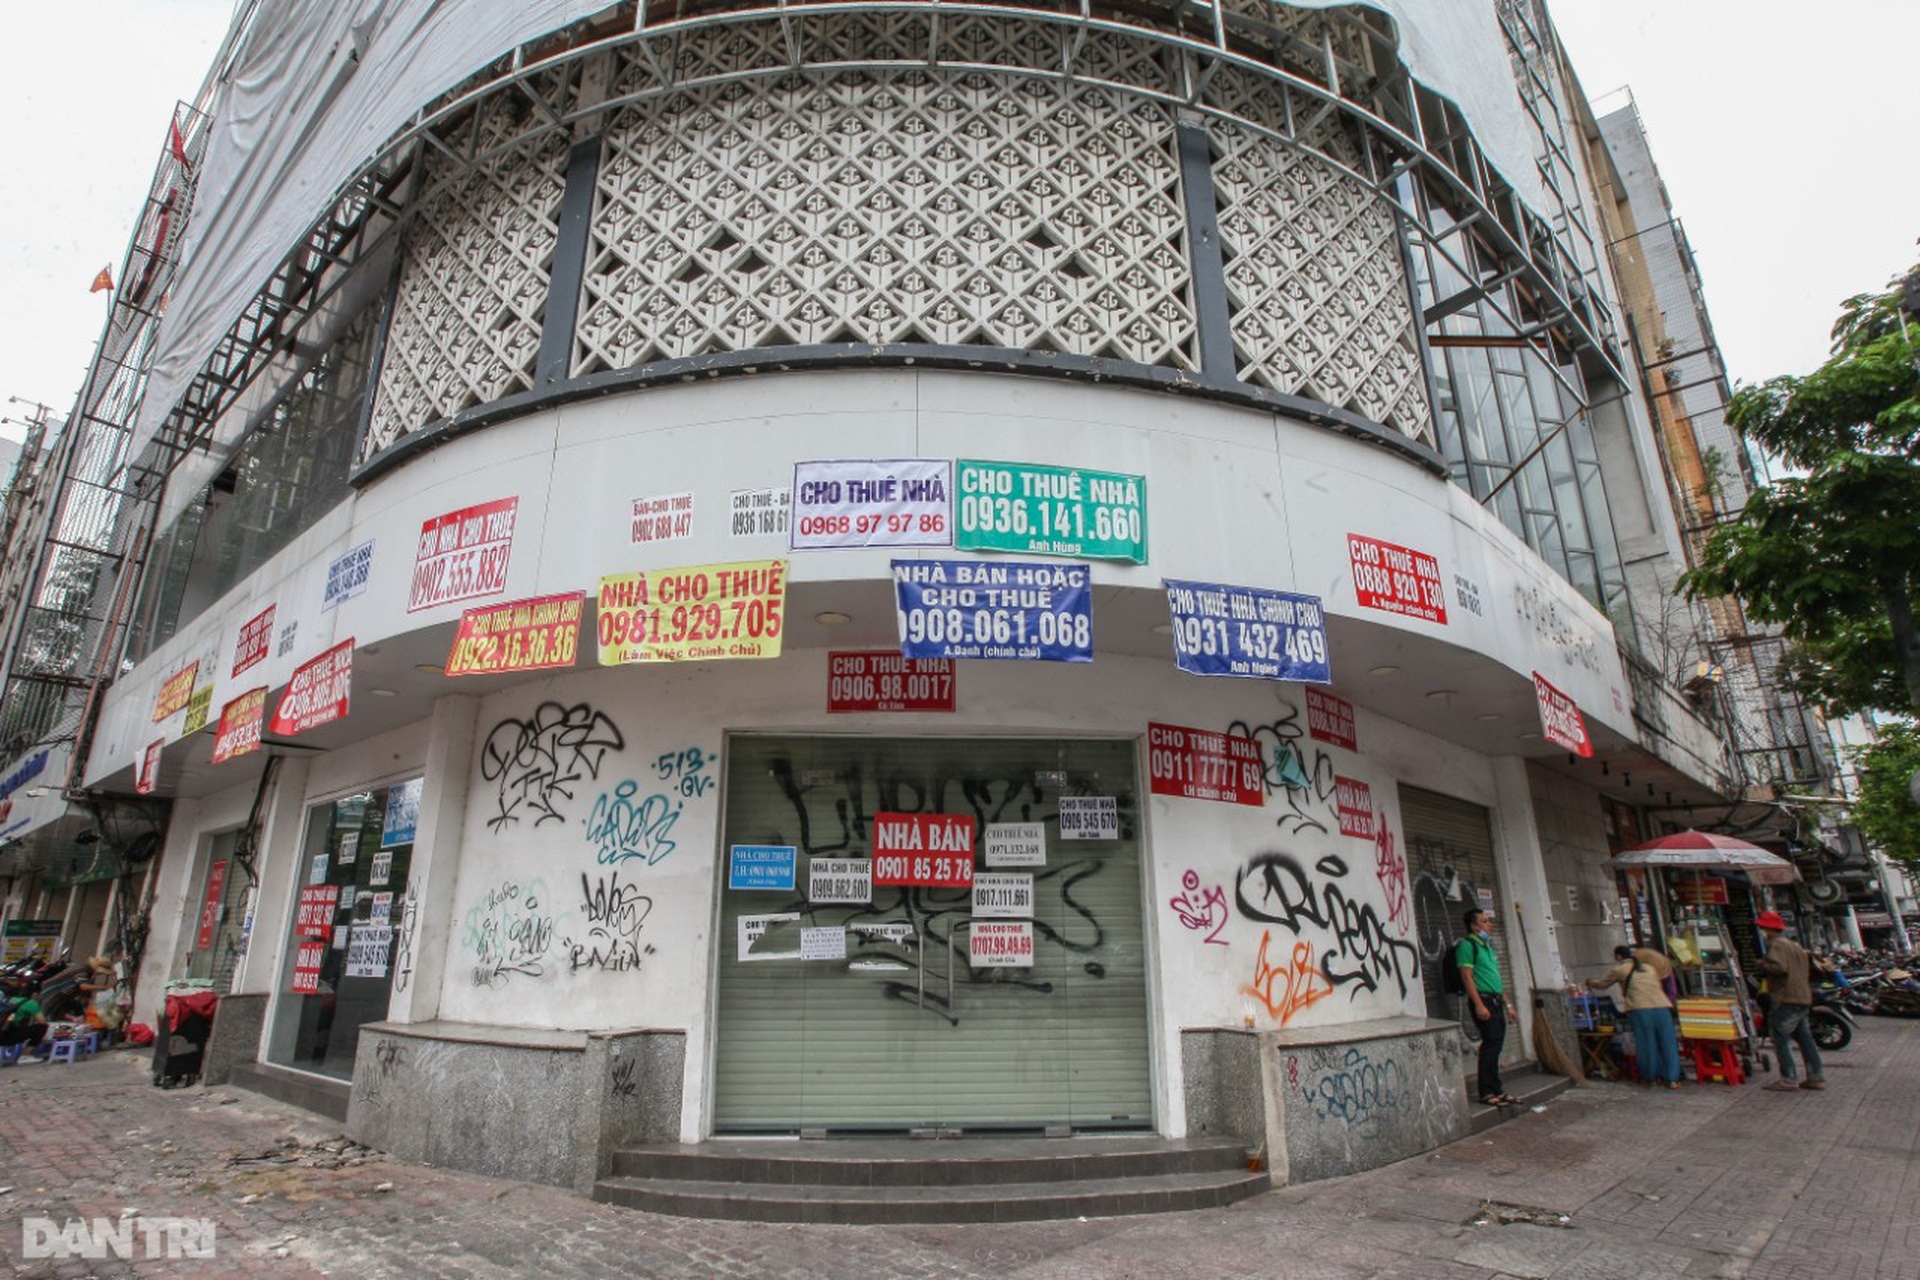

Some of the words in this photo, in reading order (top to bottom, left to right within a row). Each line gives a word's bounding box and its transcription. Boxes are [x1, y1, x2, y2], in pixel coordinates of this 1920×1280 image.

[733, 495, 751, 509] CHO
[801, 480, 841, 505] CHO
[846, 475, 897, 504] THUÊ
[901, 474, 945, 504] NHÀ
[962, 468, 1013, 496] CHO
[1020, 471, 1082, 501] THUÊ
[1090, 478, 1141, 507] NHÀ
[460, 515, 484, 547] CHO
[485, 502, 517, 543] THUÊ
[733, 510, 755, 535] 0936
[777, 510, 788, 532] 61
[800, 515, 850, 536] 0968
[856, 515, 883, 534] 97
[887, 514, 912, 533] 97
[919, 514, 945, 532] 86
[961, 496, 1141, 545] 0936.141.660
[1029, 539, 1050, 551] Anh
[1350, 539, 1380, 566] CHO
[1382, 547, 1414, 575] THUÊ
[1415, 555, 1440, 583] NHÀ
[411, 545, 509, 607] 0902.555.882
[600, 572, 649, 608] NHÀ
[658, 573, 708, 604] CHO
[716, 561, 785, 599] THUÊ
[895, 562, 947, 584] NHÀ
[957, 563, 1008, 585] BÁN
[1017, 565, 1085, 591] HOẶC
[1354, 562, 1392, 597] 0888
[1393, 572, 1419, 603] 920
[1421, 579, 1444, 610] 130
[922, 588, 976, 606] CHO
[986, 587, 1053, 608] THUÊ
[1167, 588, 1195, 615] CHO
[1196, 588, 1230, 618] THUÊ
[1231, 591, 1258, 621] NHÀ
[599, 599, 781, 646] 0981.929.705
[450, 625, 577, 672] 0922.16.36.36
[1174, 617, 1230, 657] 0931
[1239, 622, 1280, 661] 432
[1285, 628, 1326, 665] 469
[833, 657, 866, 674] CHO
[832, 675, 952, 701] 0906.98.0017
[1150, 728, 1184, 748] CHO
[1188, 734, 1227, 754] THUÊ
[1231, 740, 1259, 760] NHÀ
[1152, 749, 1194, 782] 0911
[1200, 755, 1237, 787] 7777
[1242, 762, 1261, 791] 69
[1060, 799, 1077, 810] CHO
[878, 817, 923, 850] NHÀ
[929, 818, 970, 852] BÁN
[1083, 812, 1099, 830] 545
[1101, 812, 1117, 830] 670
[831, 863, 848, 873] CHO
[877, 856, 909, 879] 0901
[914, 857, 931, 880] 85
[935, 858, 951, 880] 25
[955, 858, 971, 881] 78
